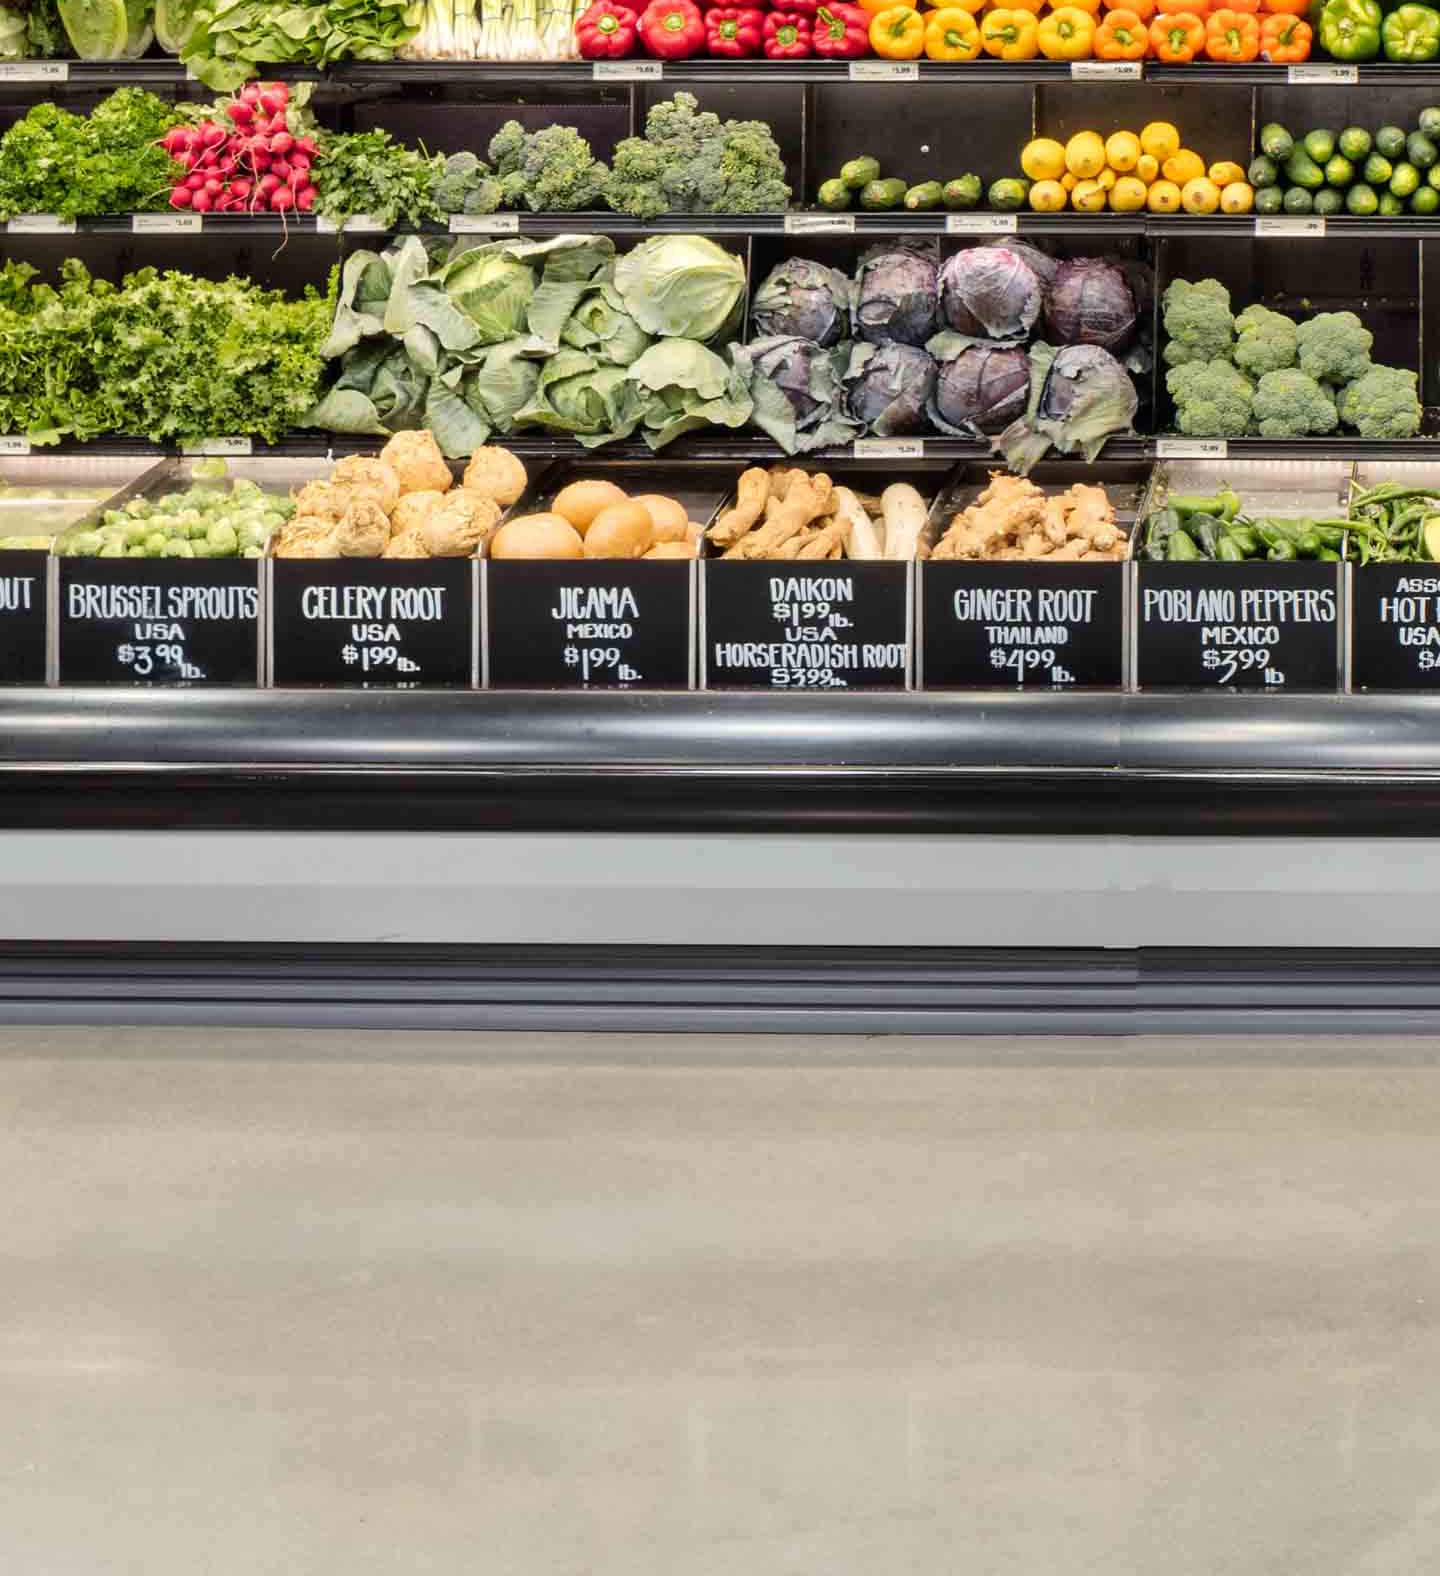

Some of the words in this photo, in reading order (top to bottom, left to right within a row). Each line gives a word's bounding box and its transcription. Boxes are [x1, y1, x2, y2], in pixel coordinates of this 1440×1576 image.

[69, 584, 168, 619] BRUSSEL
[169, 587, 258, 620] SPROUTS
[302, 585, 390, 621] CELERY
[391, 586, 447, 621] ROOT
[551, 586, 640, 621] JICAMA
[769, 577, 854, 603] DAIKON
[953, 588, 1033, 624] GINGER
[1038, 588, 1098, 624] ROOT
[1143, 588, 1236, 623] POBLANO
[1240, 588, 1336, 623] PEPPERS
[1380, 596, 1431, 624] HOT
[134, 623, 185, 641] USA
[351, 623, 401, 642] USA
[566, 623, 633, 640] MEXICO
[784, 625, 838, 642] USA
[984, 625, 1069, 645] THAILAND
[1201, 625, 1280, 645] MEXICO
[715, 642, 859, 670] HORSERADISH
[862, 643, 908, 670] ROOT
